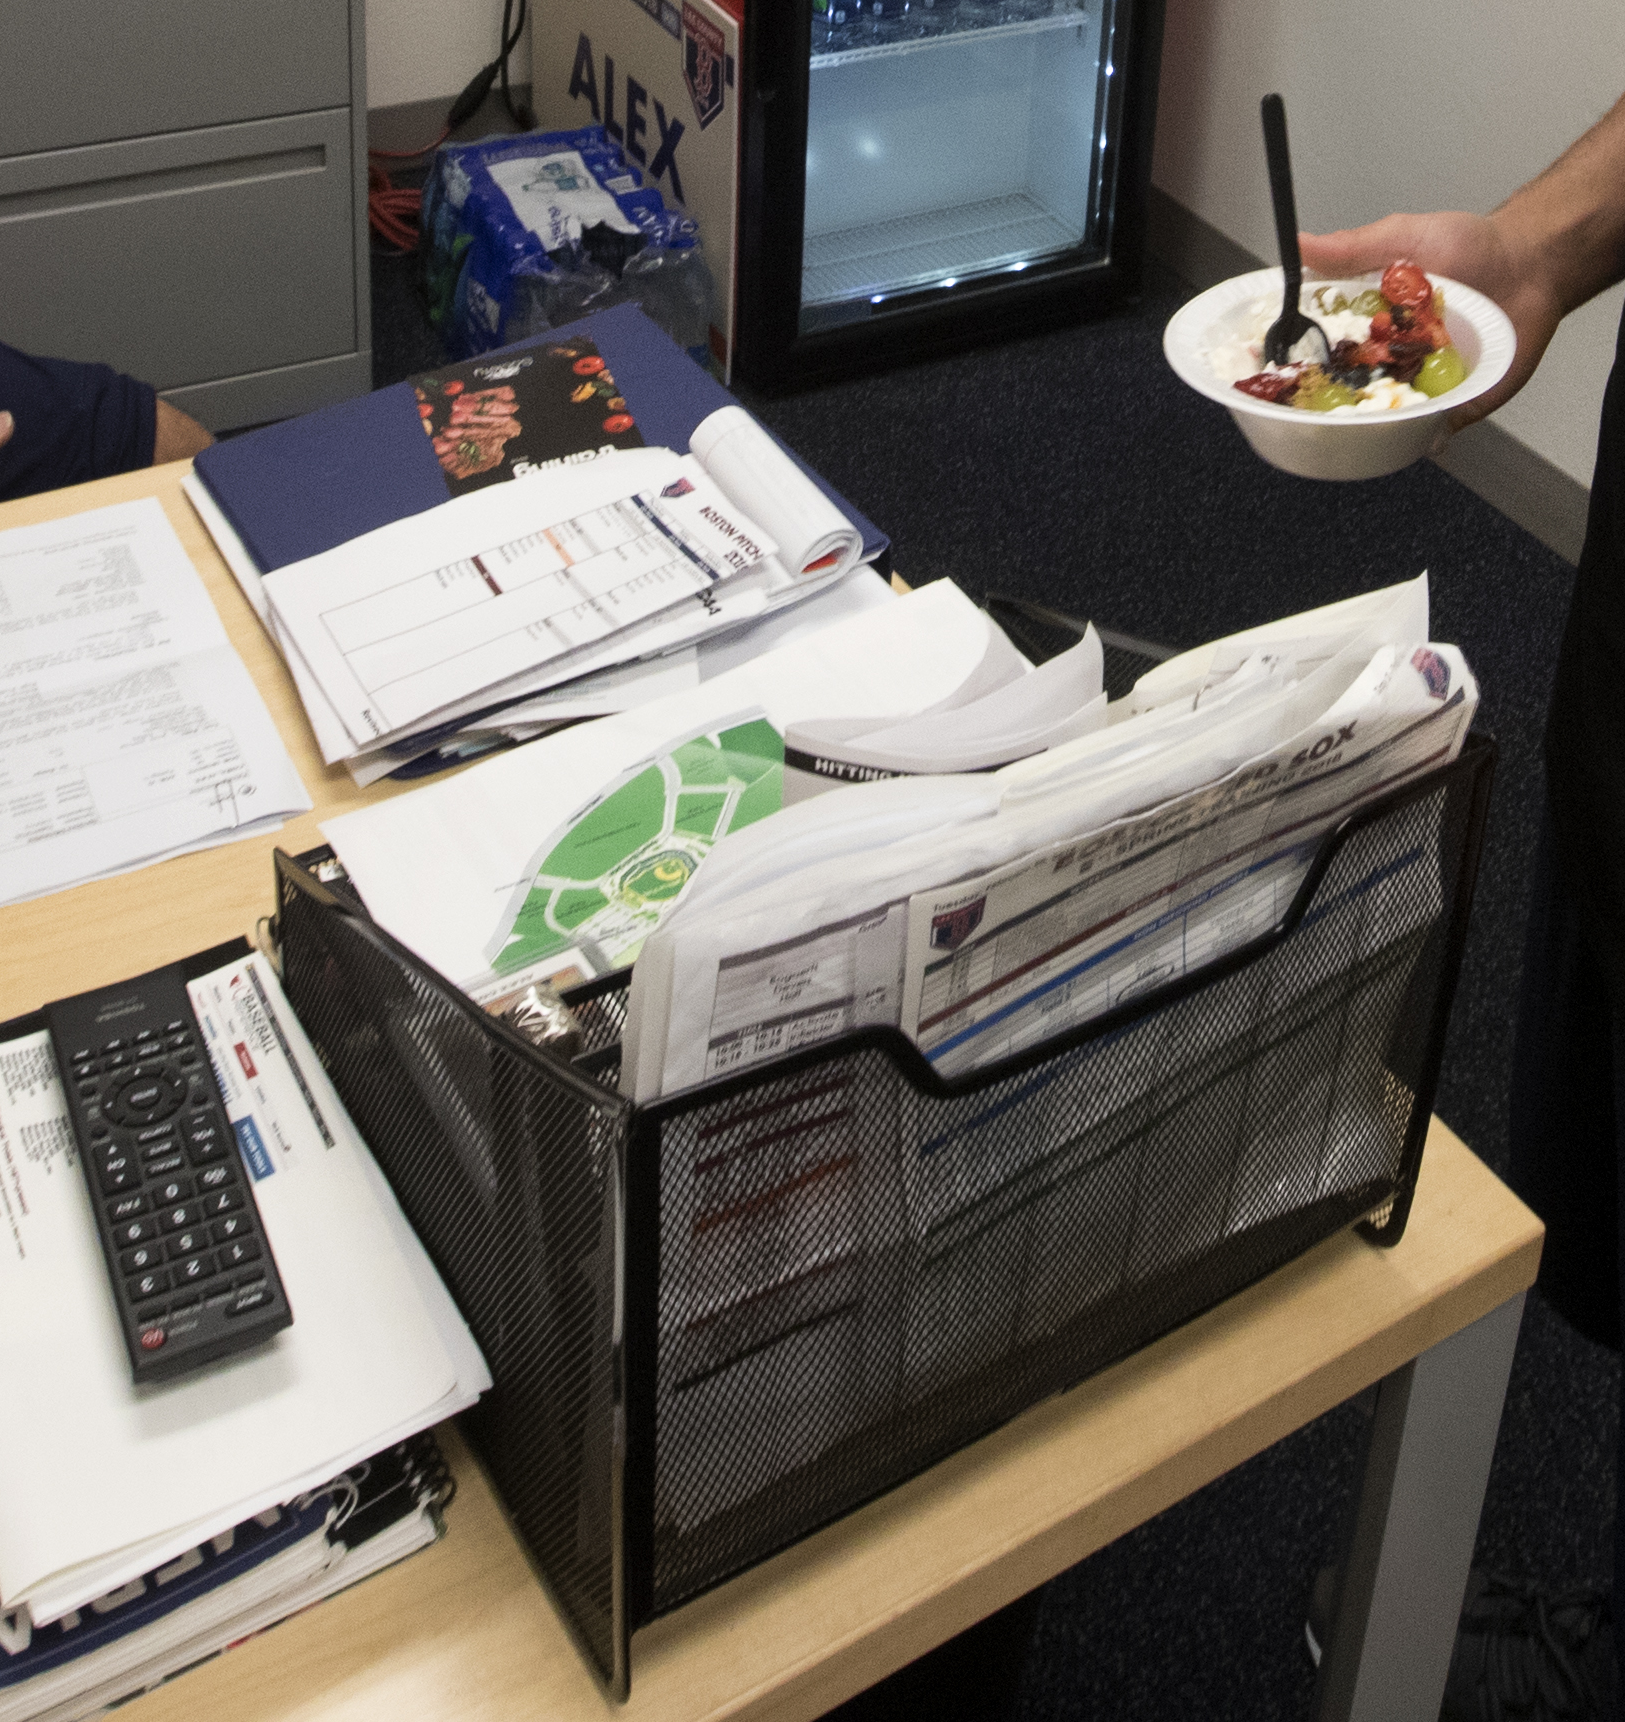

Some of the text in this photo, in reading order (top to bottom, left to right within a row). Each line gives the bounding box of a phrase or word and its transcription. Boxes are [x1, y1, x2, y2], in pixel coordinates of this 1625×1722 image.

[569, 30, 685, 206] ALEX
[1288, 719, 1359, 772] SOX
[218, 1192, 231, 1210] 7
[186, 1243, 244, 1276] 1 2
